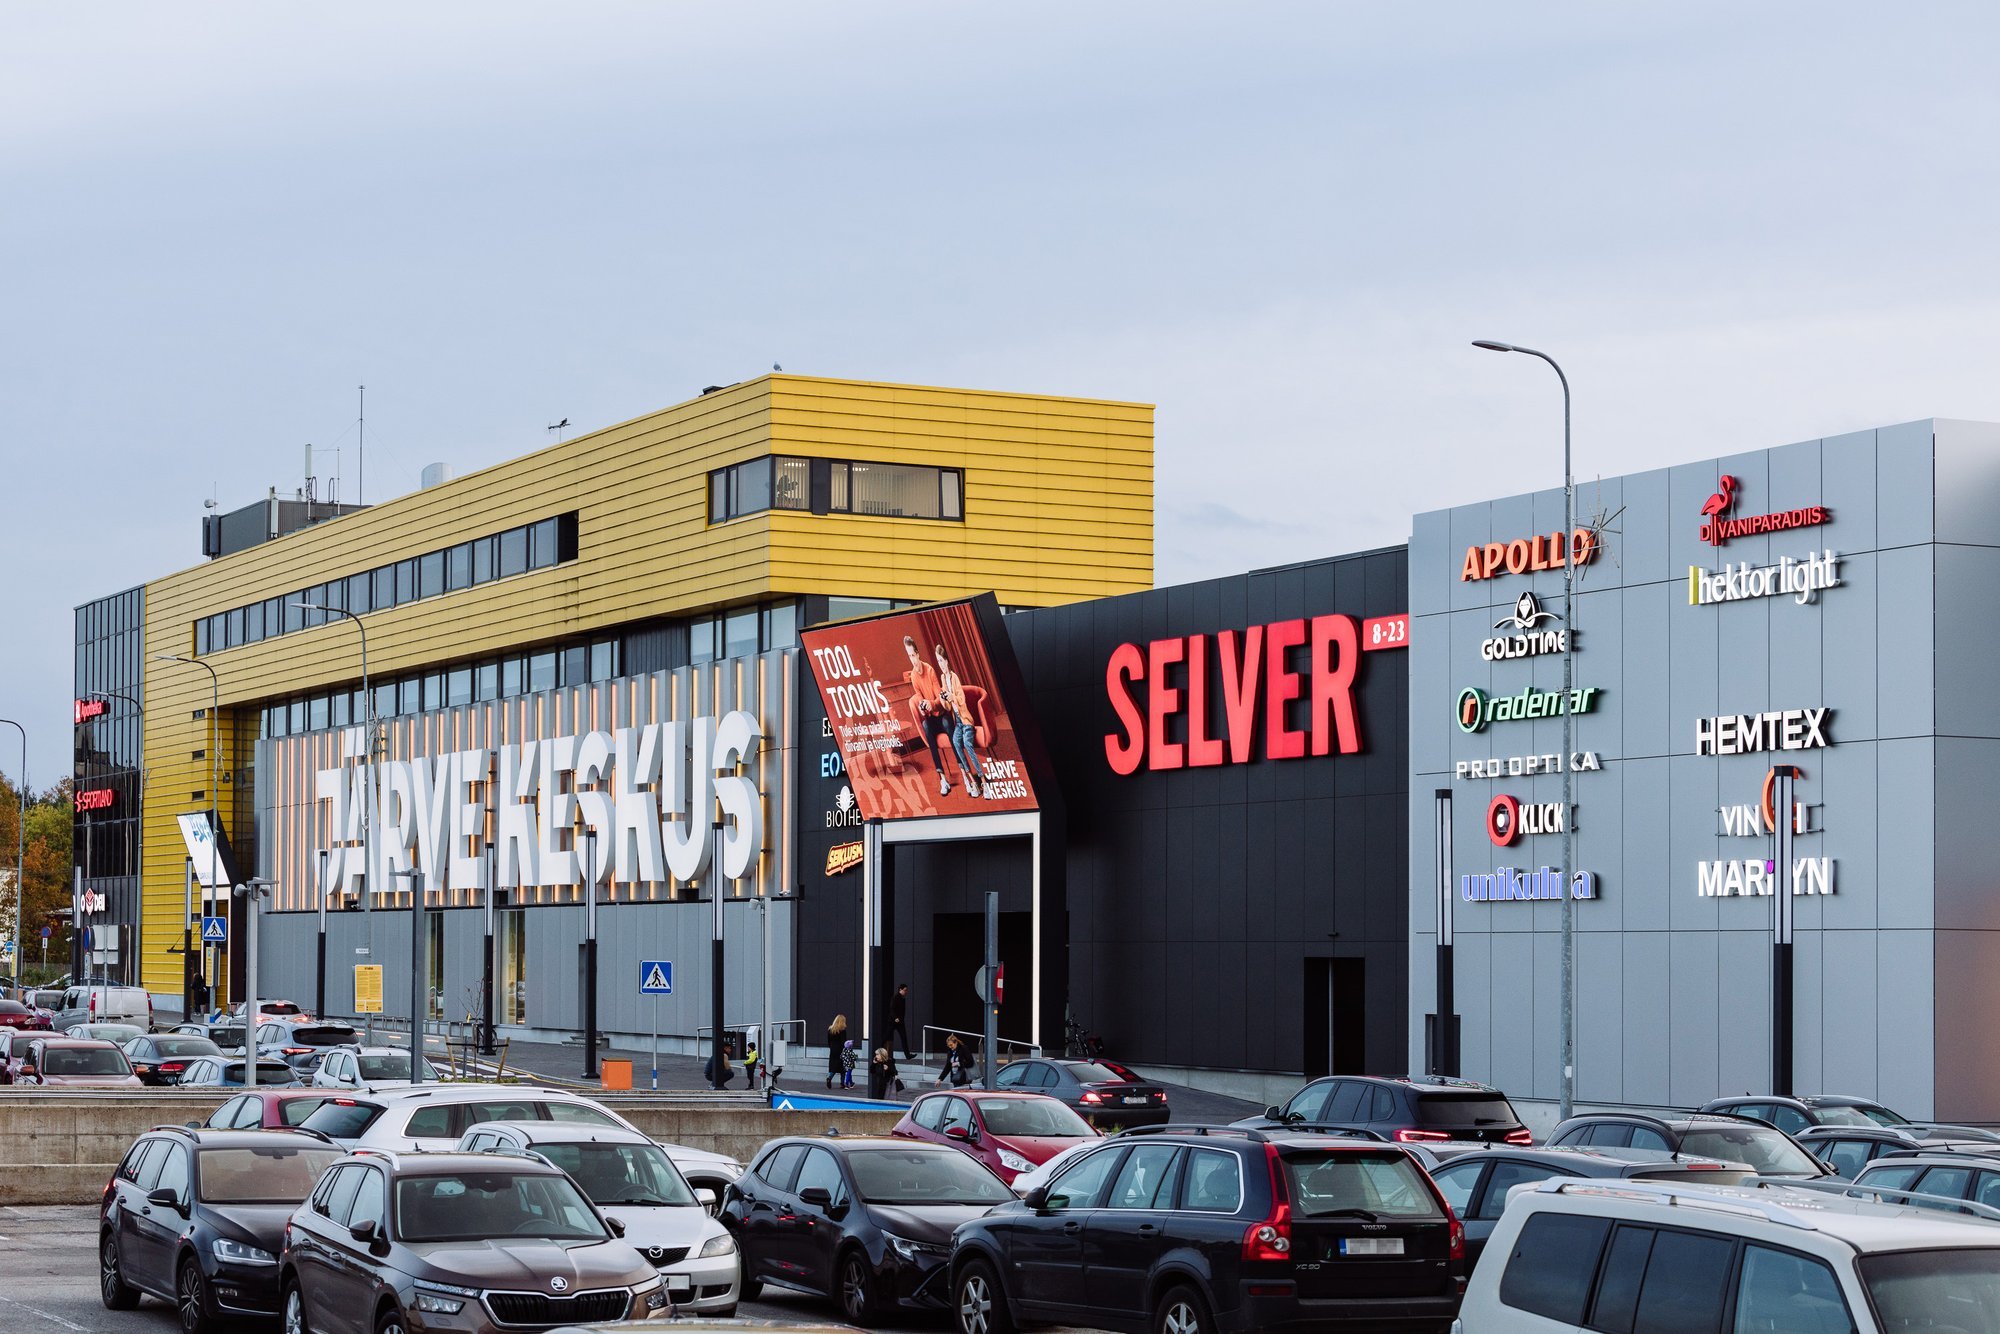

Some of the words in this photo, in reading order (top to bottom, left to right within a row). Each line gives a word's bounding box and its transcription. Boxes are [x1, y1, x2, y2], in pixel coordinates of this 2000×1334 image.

[1461, 528, 1594, 582] APOLLO
[1372, 620, 1405, 645] 8-23
[813, 644, 861, 681] TOOL
[826, 680, 889, 718] TOONIS
[1104, 613, 1362, 776] SELVER
[1486, 687, 1598, 722] rademar
[1696, 707, 1828, 756] HEMTEX
[982, 757, 1019, 780] JÄRVE
[1456, 758, 1500, 780] PRO
[313, 727, 491, 896] JÄRVE
[498, 710, 763, 888] KESKUS
[985, 779, 1027, 800] KESKUS
[1518, 803, 1564, 834] KLICK
